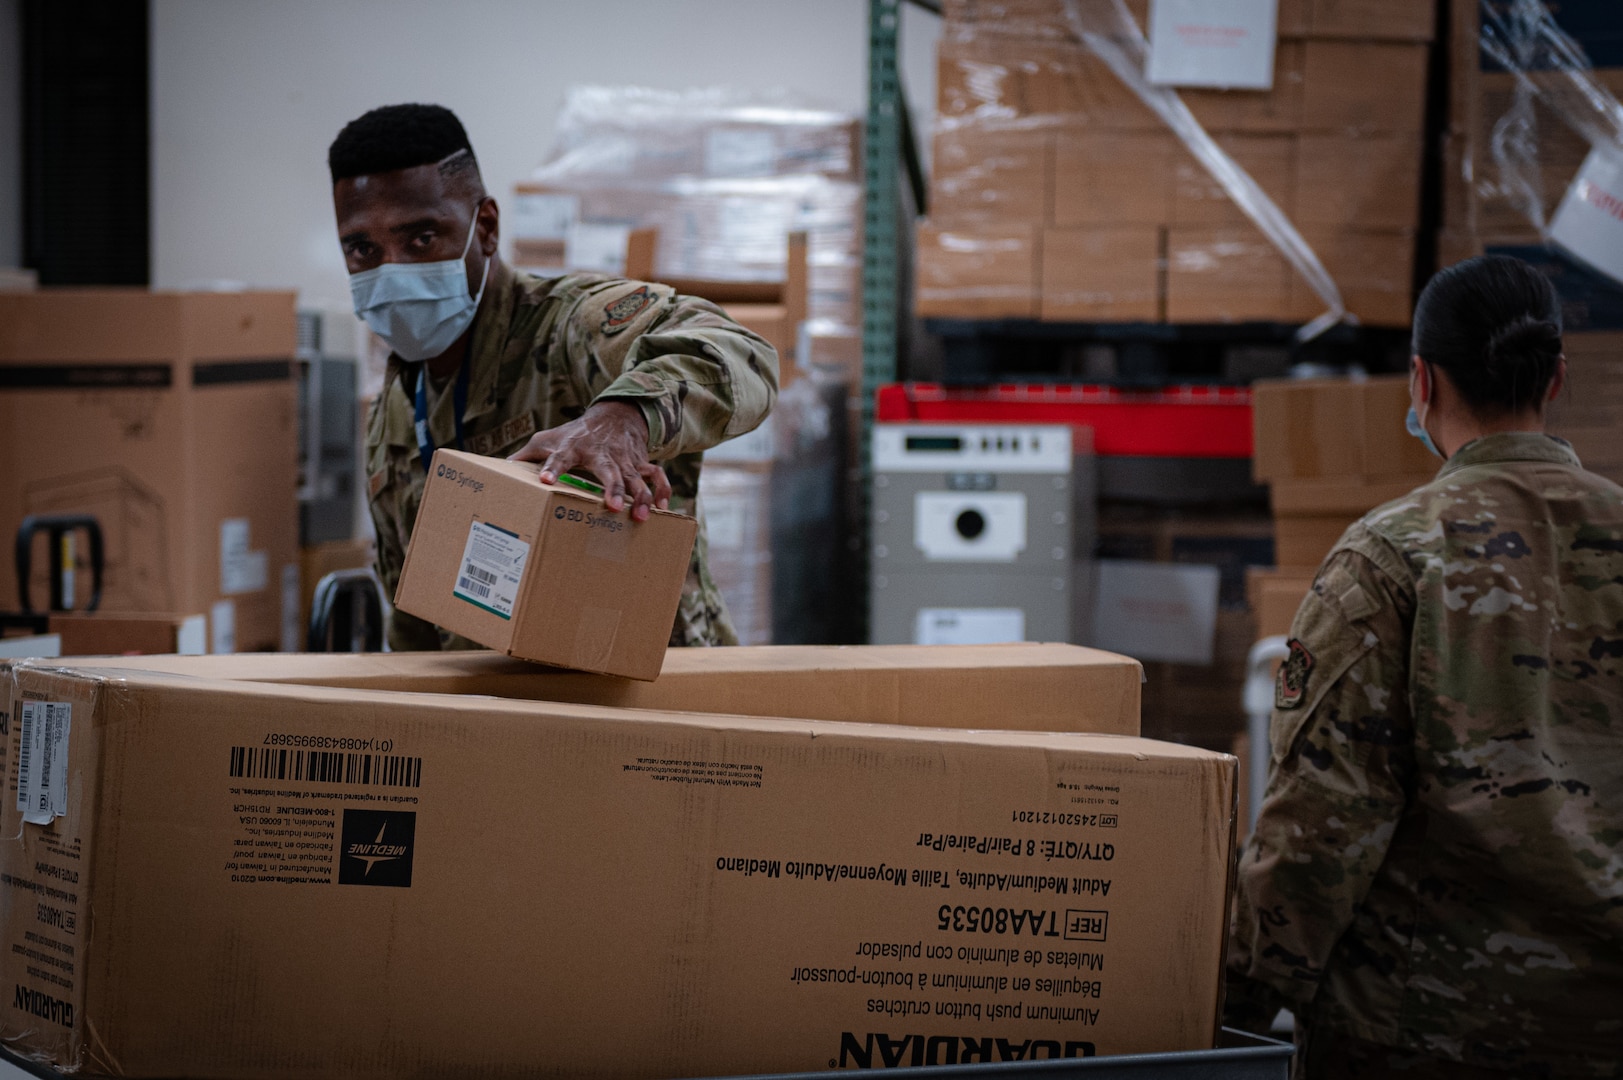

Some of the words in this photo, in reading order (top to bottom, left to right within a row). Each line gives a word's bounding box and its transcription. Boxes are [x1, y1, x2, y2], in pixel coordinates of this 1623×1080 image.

[446, 468, 457, 480] BD
[457, 472, 484, 493] Syringe
[568, 510, 584, 522] BD
[584, 512, 623, 532] Syringe
[264, 733, 392, 752] (01)40884389953687
[669, 776, 692, 784] Rubber
[277, 790, 301, 798] Medline
[311, 792, 343, 800] trademark
[344, 793, 376, 801] registered
[390, 796, 418, 804] Guardian
[233, 804, 270, 813] RD15HCR
[276, 806, 335, 816] 1-800-MEDLINE
[240, 816, 257, 824] USA
[260, 817, 282, 825] 60060
[293, 818, 335, 827] Mundelein,
[1011, 810, 1097, 826] 24520121201
[263, 828, 301, 838] Industries,
[303, 830, 334, 839] Medline
[233, 838, 253, 847] para:
[255, 840, 282, 849] Taiwan
[296, 842, 333, 851] Fabricado
[348, 843, 406, 856] MEDLINE
[916, 833, 1022, 856] Pair/Paire/Par
[1027, 840, 1035, 856] 8
[1040, 840, 1115, 861] QTY/QTÉ:
[258, 852, 285, 860] Taiwan
[299, 852, 332, 862] Fabriqué
[240, 863, 267, 872] Taiwan
[270, 864, 277, 872] in
[279, 864, 332, 874] Manufactured
[716, 857, 780, 878] Mediano
[786, 862, 907, 886] Moyenne/Adulto
[231, 874, 256, 882] ©2010
[258, 875, 331, 884] www.medline.com
[912, 870, 950, 888] Taille
[956, 869, 1068, 894] Medium/Adulte,
[1072, 878, 1111, 896] Adult
[938, 905, 1059, 936] TAA80535
[1070, 917, 1102, 934] REF
[856, 941, 921, 961] pulsador
[927, 946, 953, 958] con
[958, 947, 1019, 966] aluminio
[1024, 950, 1042, 968] de
[1047, 952, 1103, 971] Muletas
[791, 966, 913, 990] bouton-poussoir
[918, 973, 927, 990] à
[932, 974, 1008, 994] aluminium
[1012, 978, 1031, 989] en
[1036, 976, 1101, 998] Béquilles
[867, 1000, 930, 1017] crutches
[935, 1002, 981, 1021] button
[986, 1002, 1022, 1022] push
[1027, 1006, 1099, 1025] Aluminum
